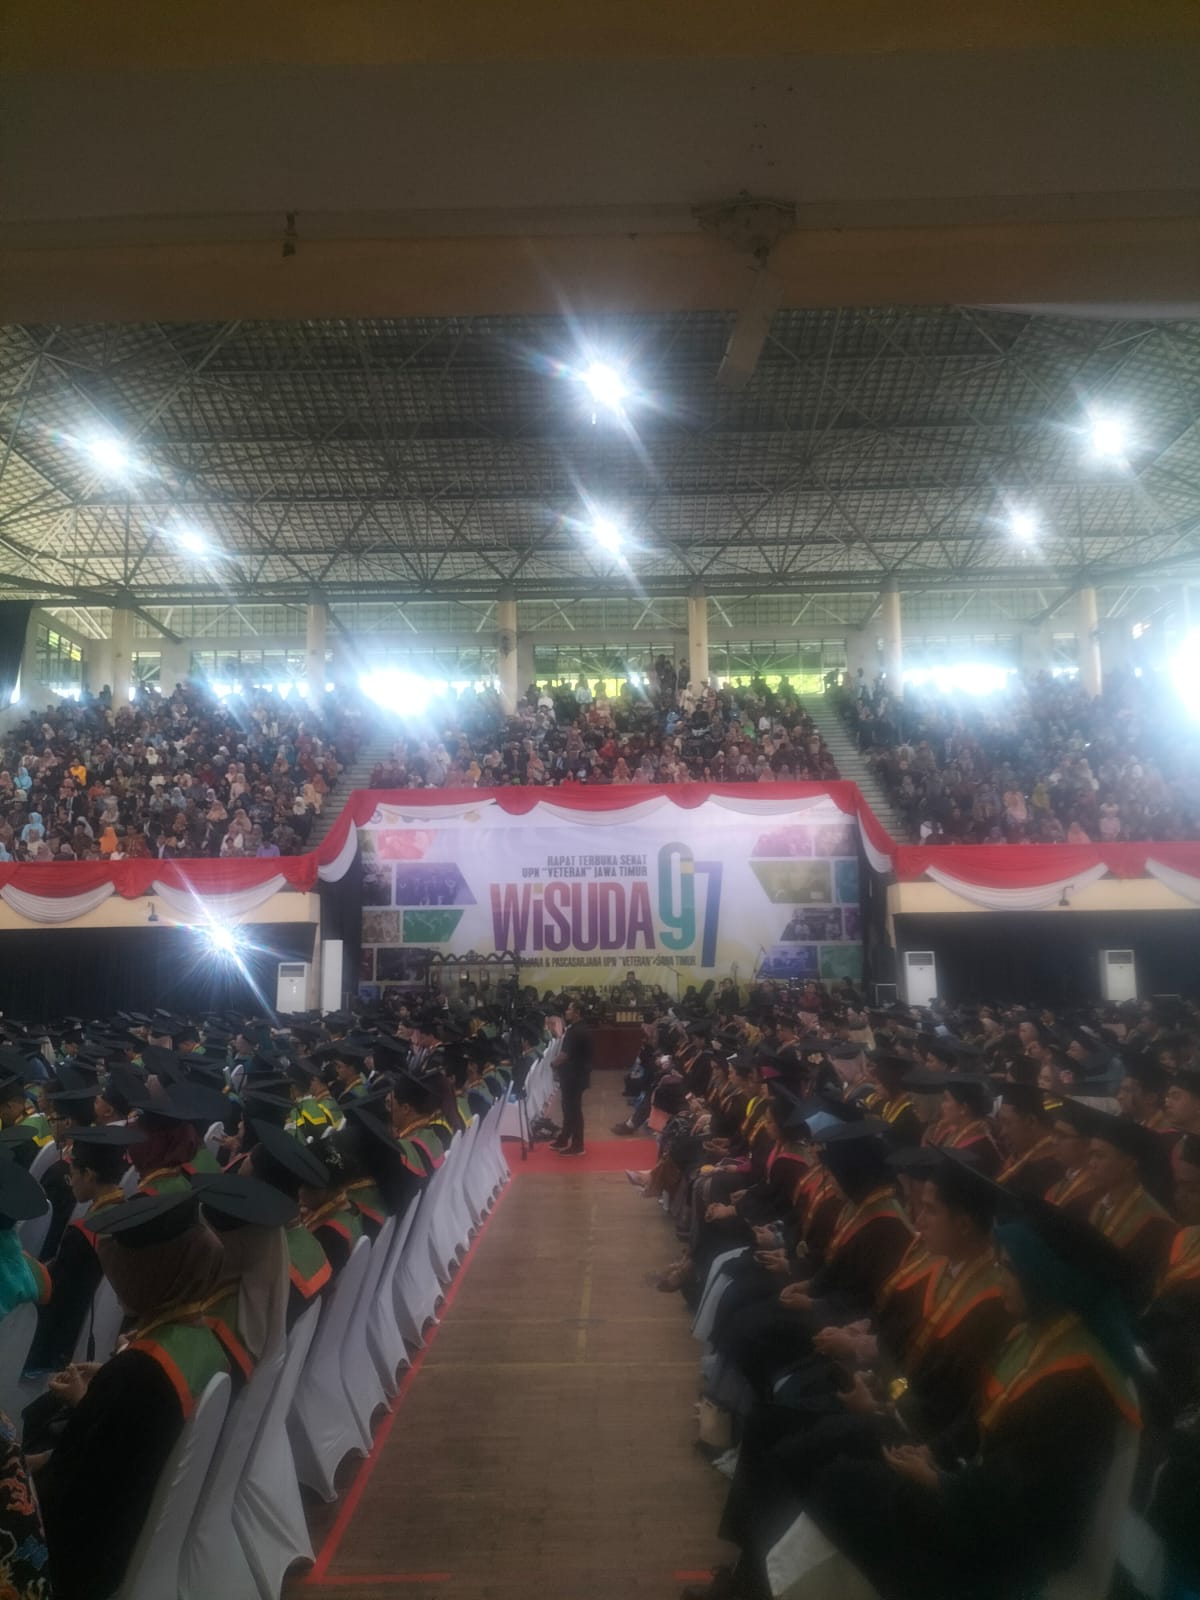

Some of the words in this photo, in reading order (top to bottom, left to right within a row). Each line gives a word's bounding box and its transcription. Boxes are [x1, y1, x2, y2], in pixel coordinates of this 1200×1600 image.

[547, 855, 576, 867] RAPAT
[579, 854, 618, 866] TERBUKA
[619, 854, 648, 865] SENAT
[522, 867, 540, 878] UPN
[593, 867, 617, 878] JAWA
[618, 866, 648, 877] TIMUR
[658, 841, 724, 968] 97
